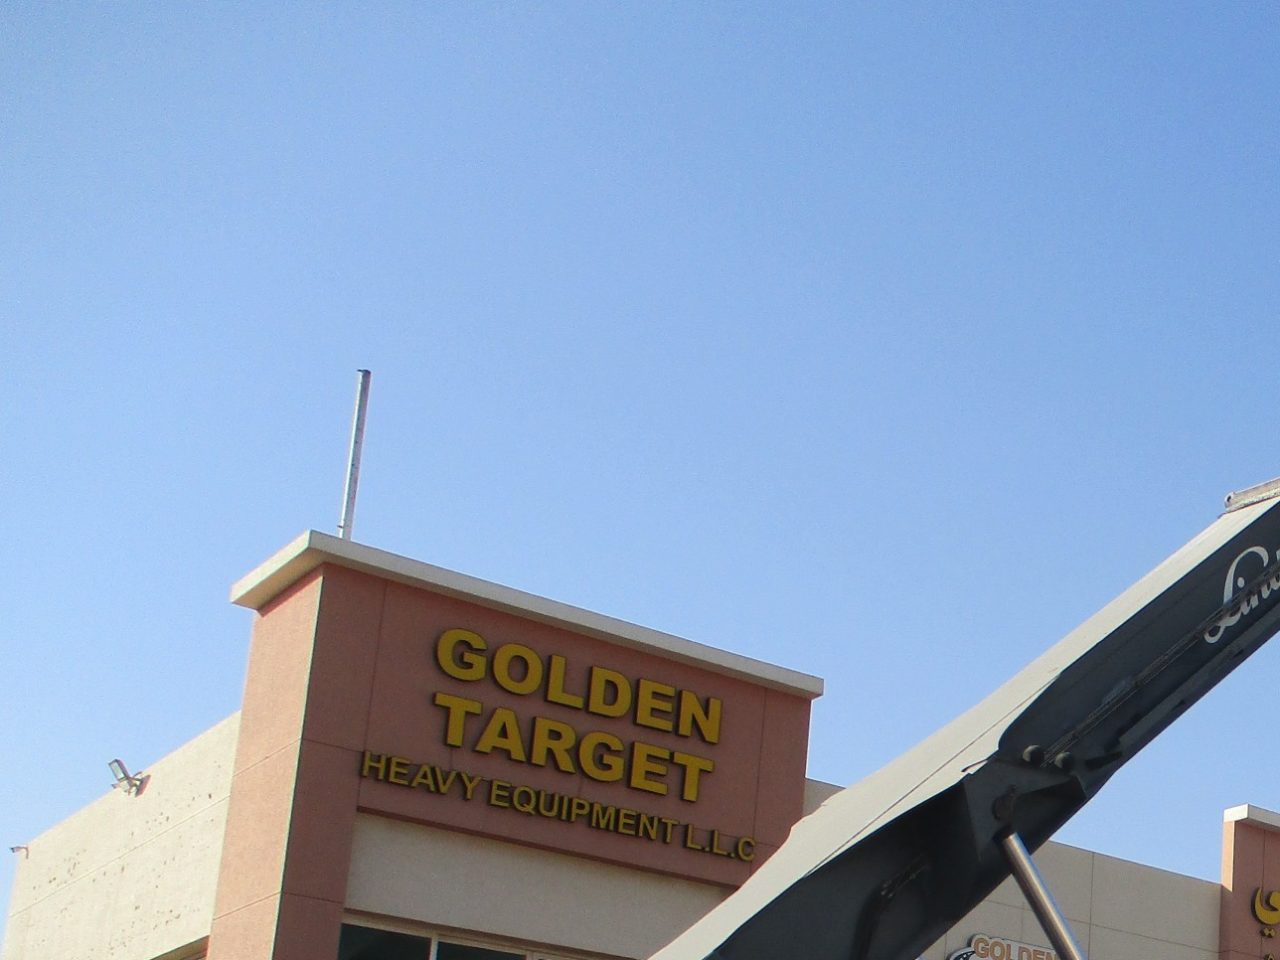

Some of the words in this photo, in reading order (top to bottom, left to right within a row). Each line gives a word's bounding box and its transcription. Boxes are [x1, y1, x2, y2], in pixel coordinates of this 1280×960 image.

[435, 627, 723, 745] GOLDEN
[432, 691, 715, 803] TARGET
[360, 750, 482, 801] HEAVY
[490, 778, 679, 844] EQUIPMENT
[685, 822, 757, 862] L.L.C
